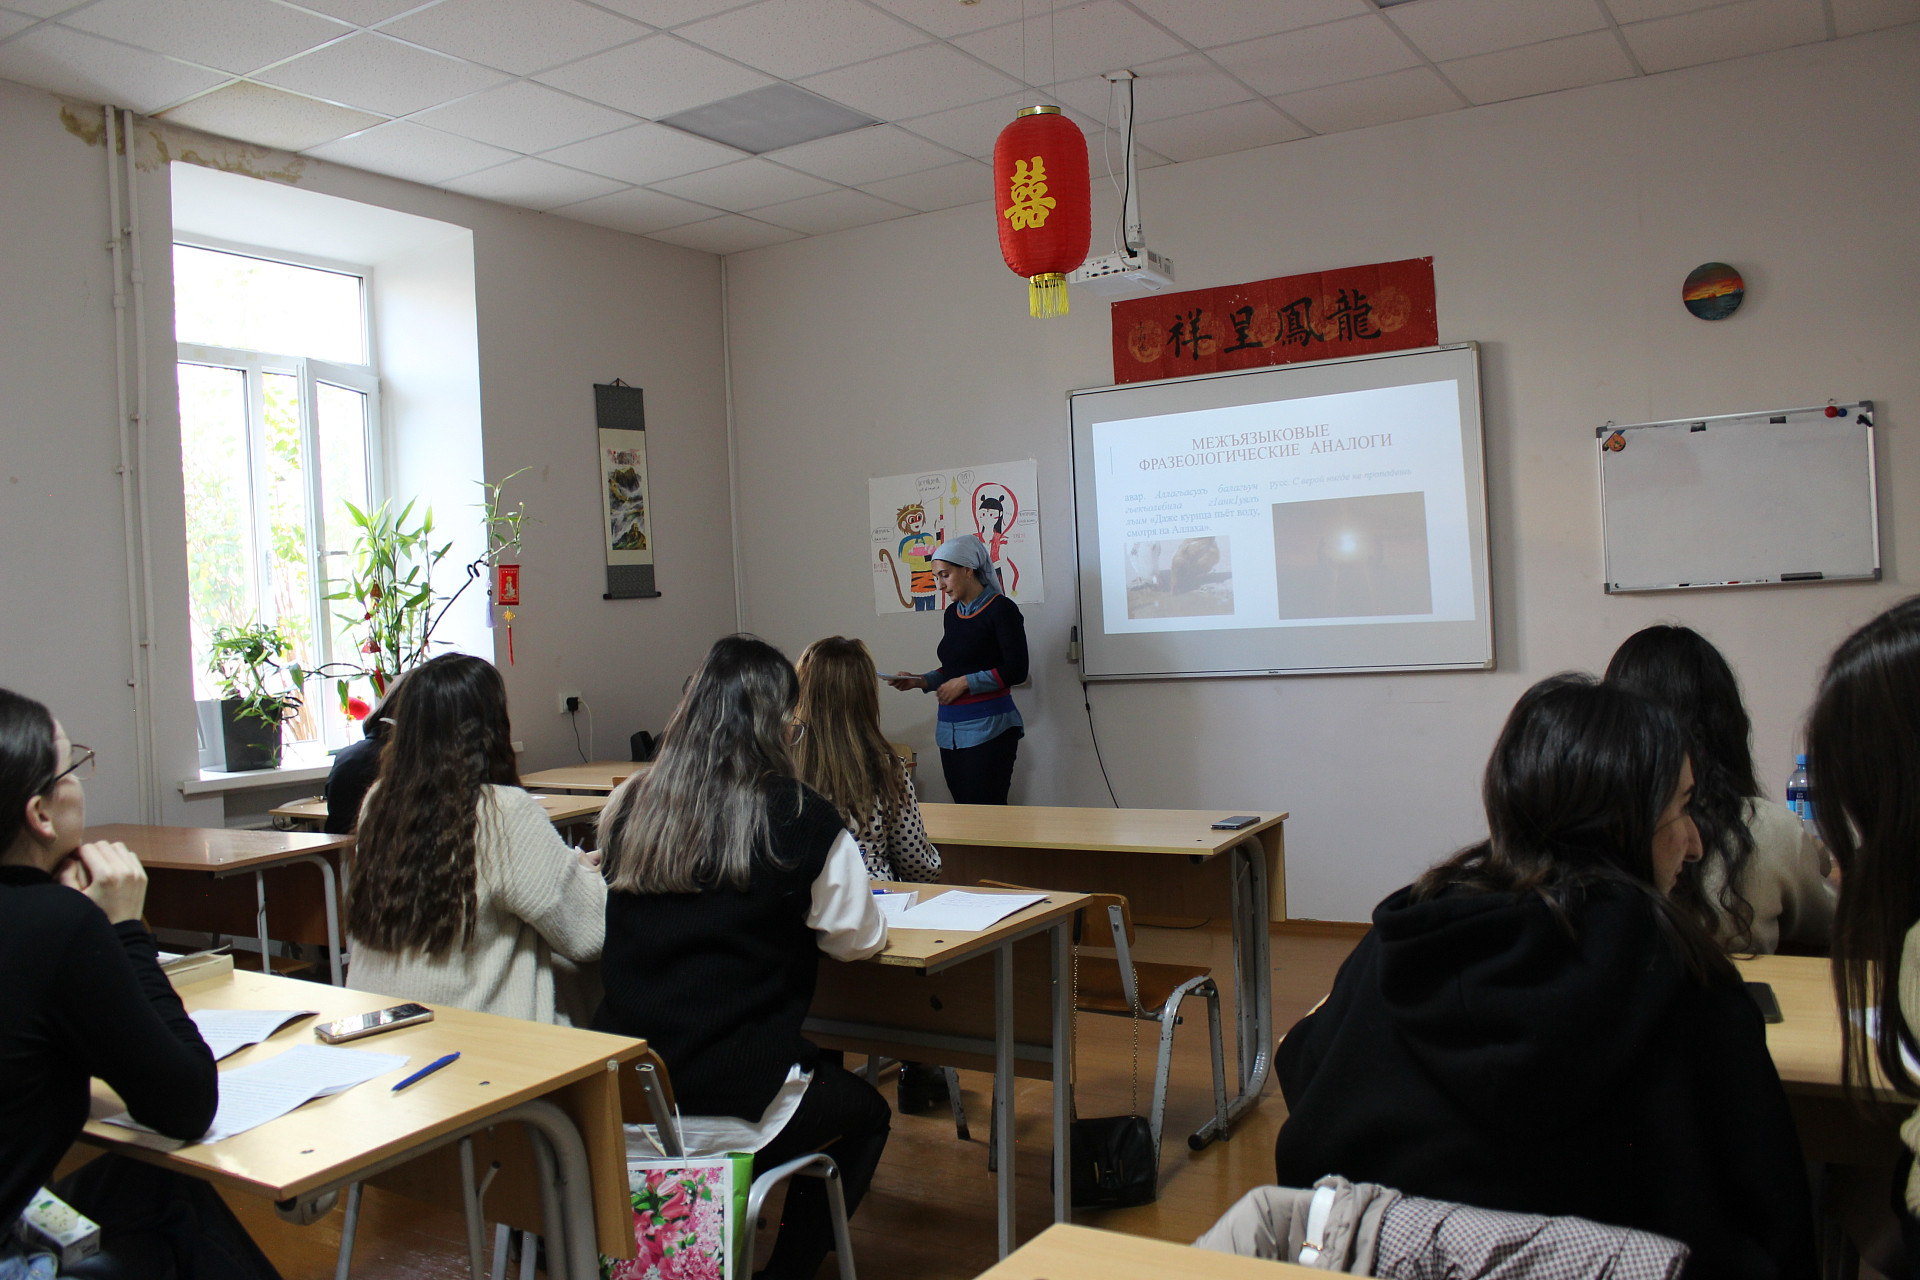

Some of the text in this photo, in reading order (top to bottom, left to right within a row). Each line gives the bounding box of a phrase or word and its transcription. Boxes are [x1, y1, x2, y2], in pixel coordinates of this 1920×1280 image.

[1191, 423, 1330, 451] МЕЖЪЯЗЫКОВЫЕ
[1138, 432, 1393, 472] ФРАЗЕОЛОГИЧЕСКИЕ АНАЛОГИ
[1124, 492, 1146, 503] авар.
[1180, 512, 1212, 524] курица
[1126, 528, 1157, 538] смотря
